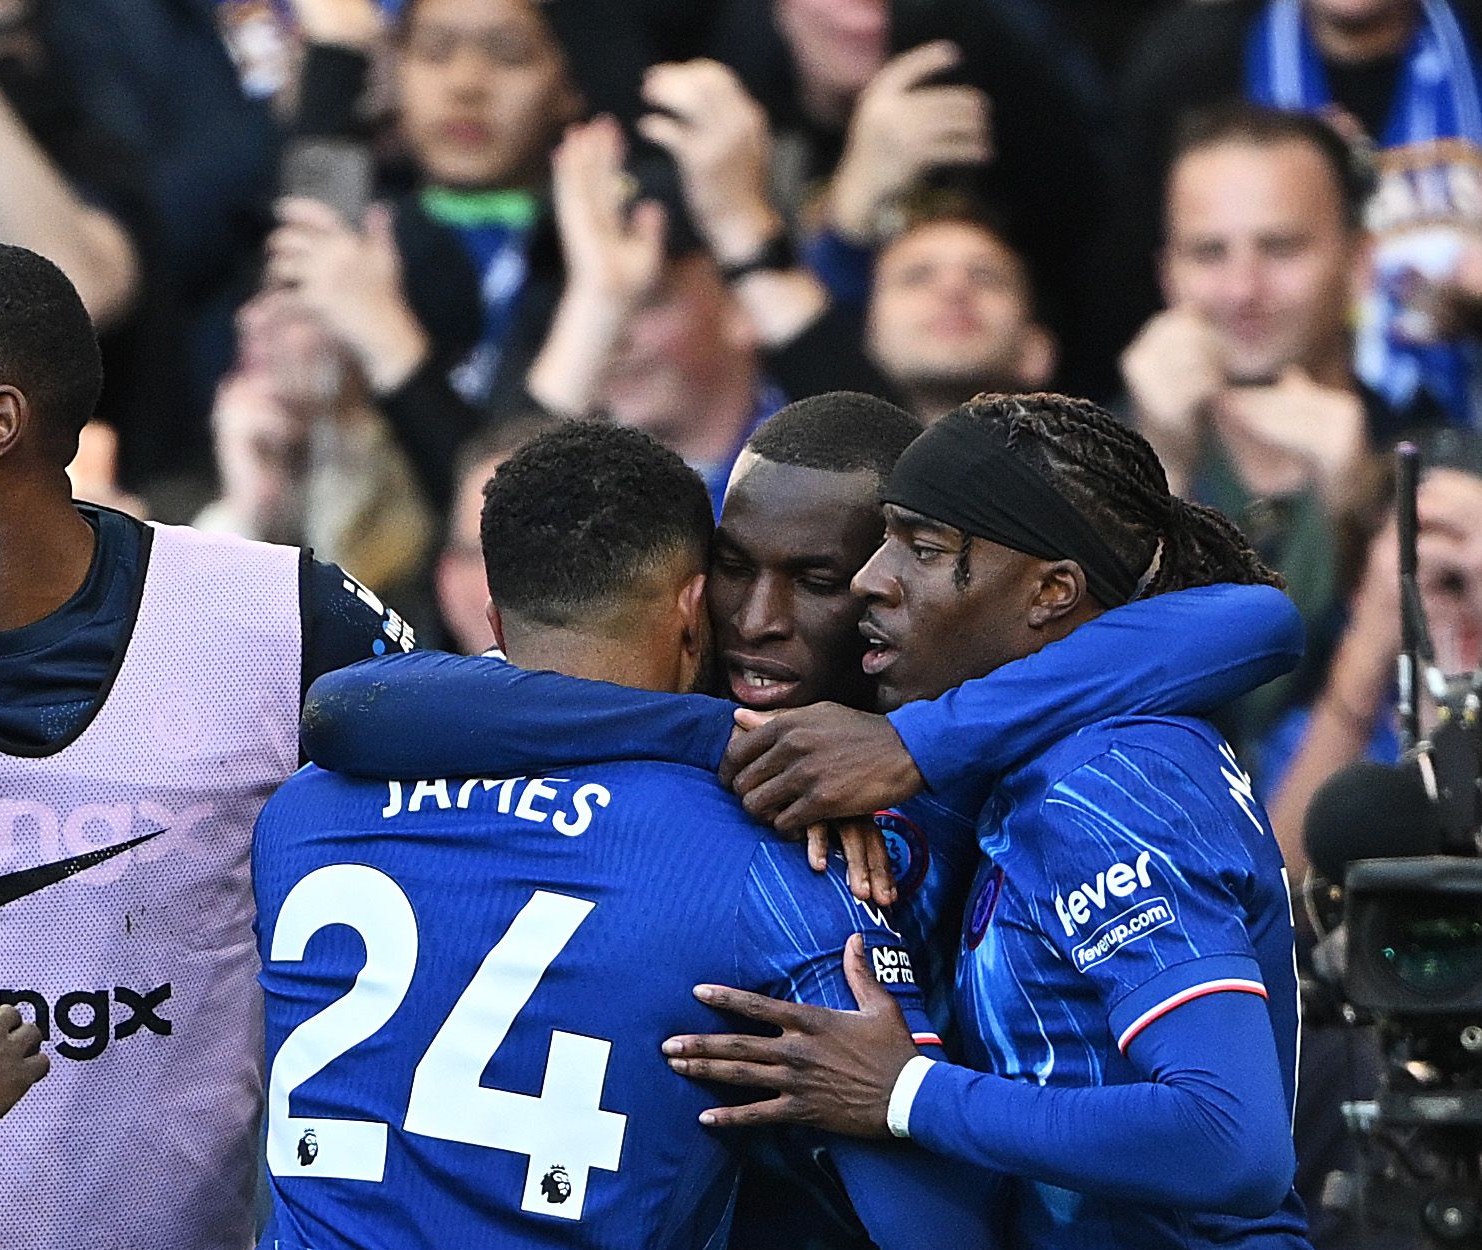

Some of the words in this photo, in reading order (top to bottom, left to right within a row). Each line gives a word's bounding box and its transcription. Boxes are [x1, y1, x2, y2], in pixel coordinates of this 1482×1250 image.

[382, 776, 611, 837] JAMES
[1055, 850, 1152, 937] fever
[872, 946, 899, 966] No
[1077, 905, 1168, 965] feverup.com
[875, 964, 900, 984] for
[266, 864, 627, 1221] 24
